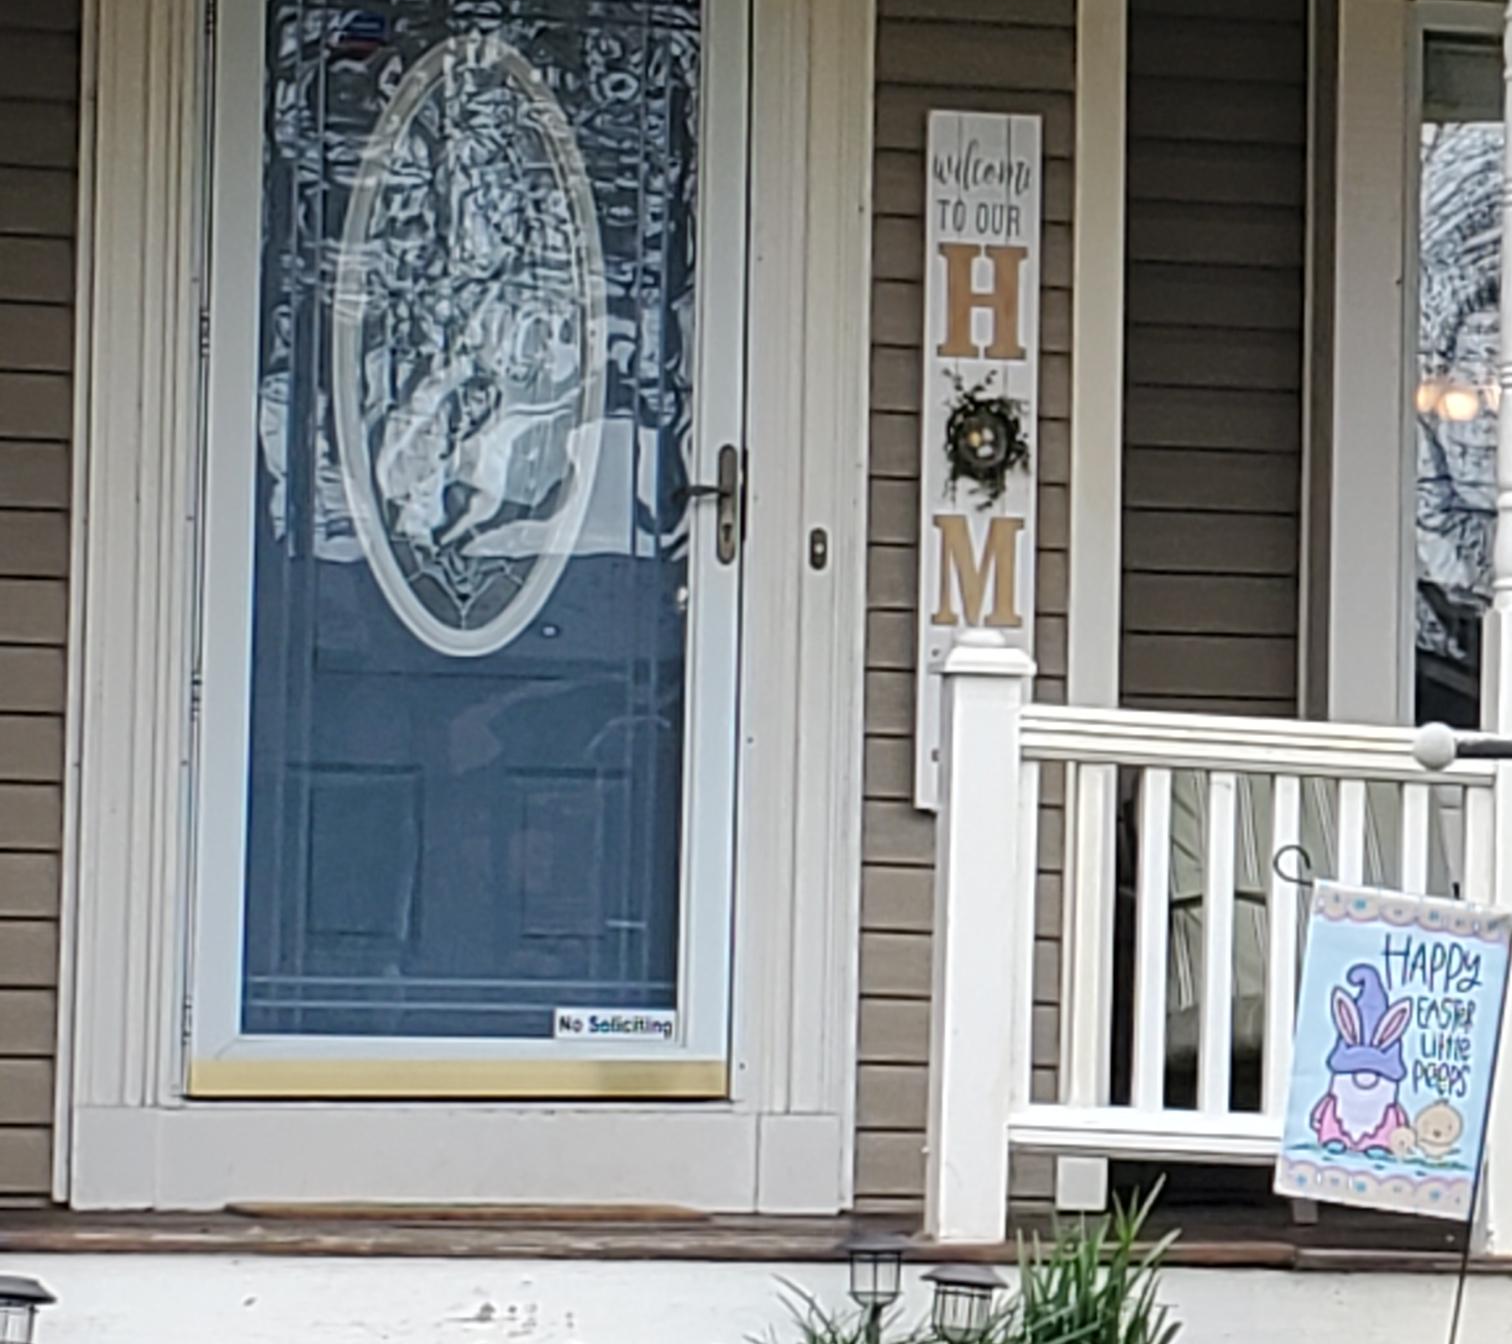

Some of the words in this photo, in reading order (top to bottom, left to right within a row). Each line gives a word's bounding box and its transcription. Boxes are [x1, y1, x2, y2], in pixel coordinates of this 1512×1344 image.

[937, 198, 966, 231] TO
[976, 202, 1020, 237] OUR
[558, 1015, 584, 1034] No
[589, 1015, 672, 1039] Soliciting
